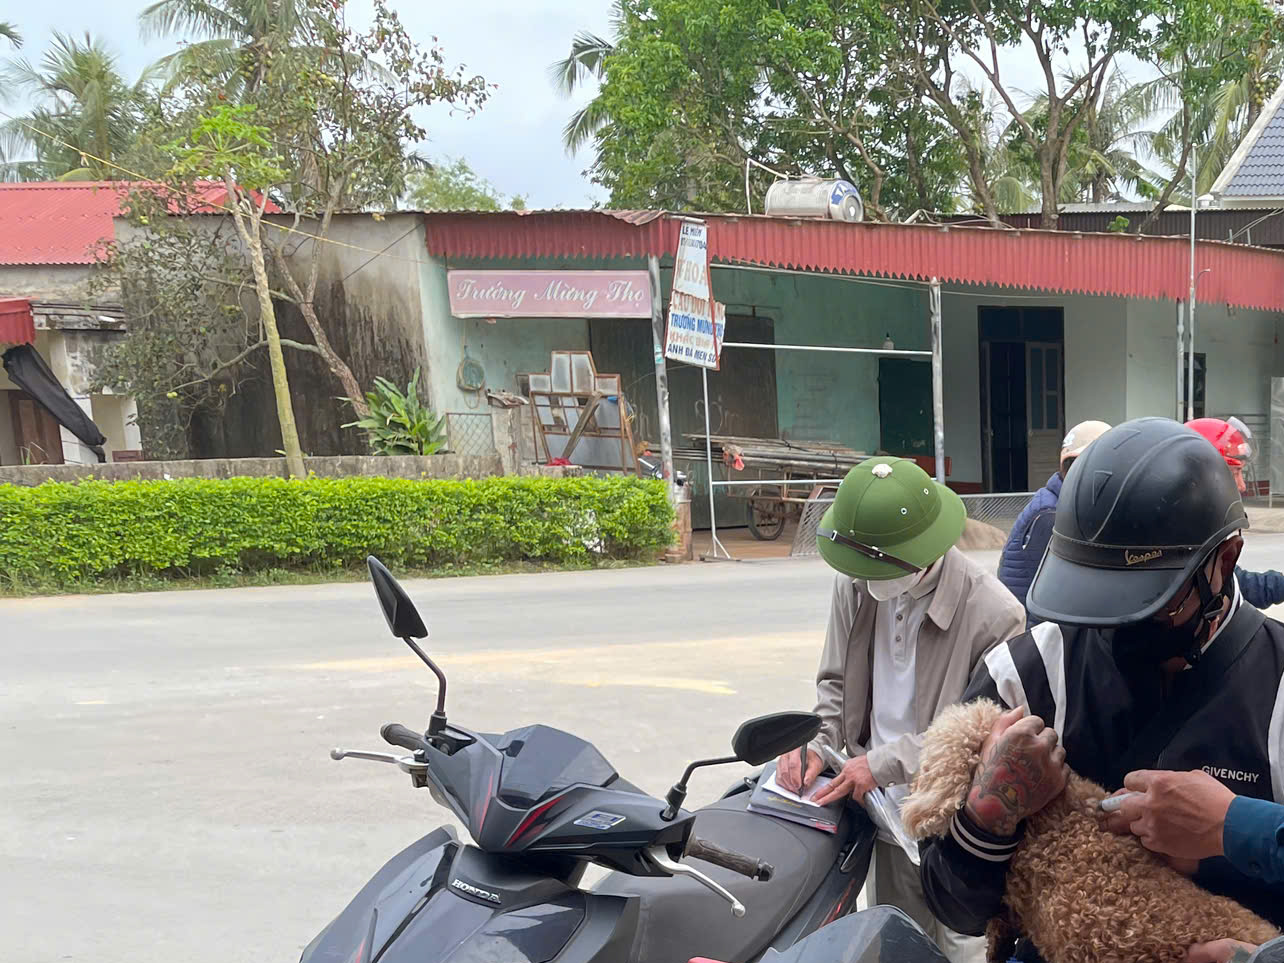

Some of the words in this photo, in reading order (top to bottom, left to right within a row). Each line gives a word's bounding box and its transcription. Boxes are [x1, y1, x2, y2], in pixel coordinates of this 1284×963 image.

[534, 280, 598, 309] Mừng
[606, 279, 645, 308] Thọ
[1202, 765, 1260, 783] GIVENCHY
[451, 878, 502, 904] HONDA
